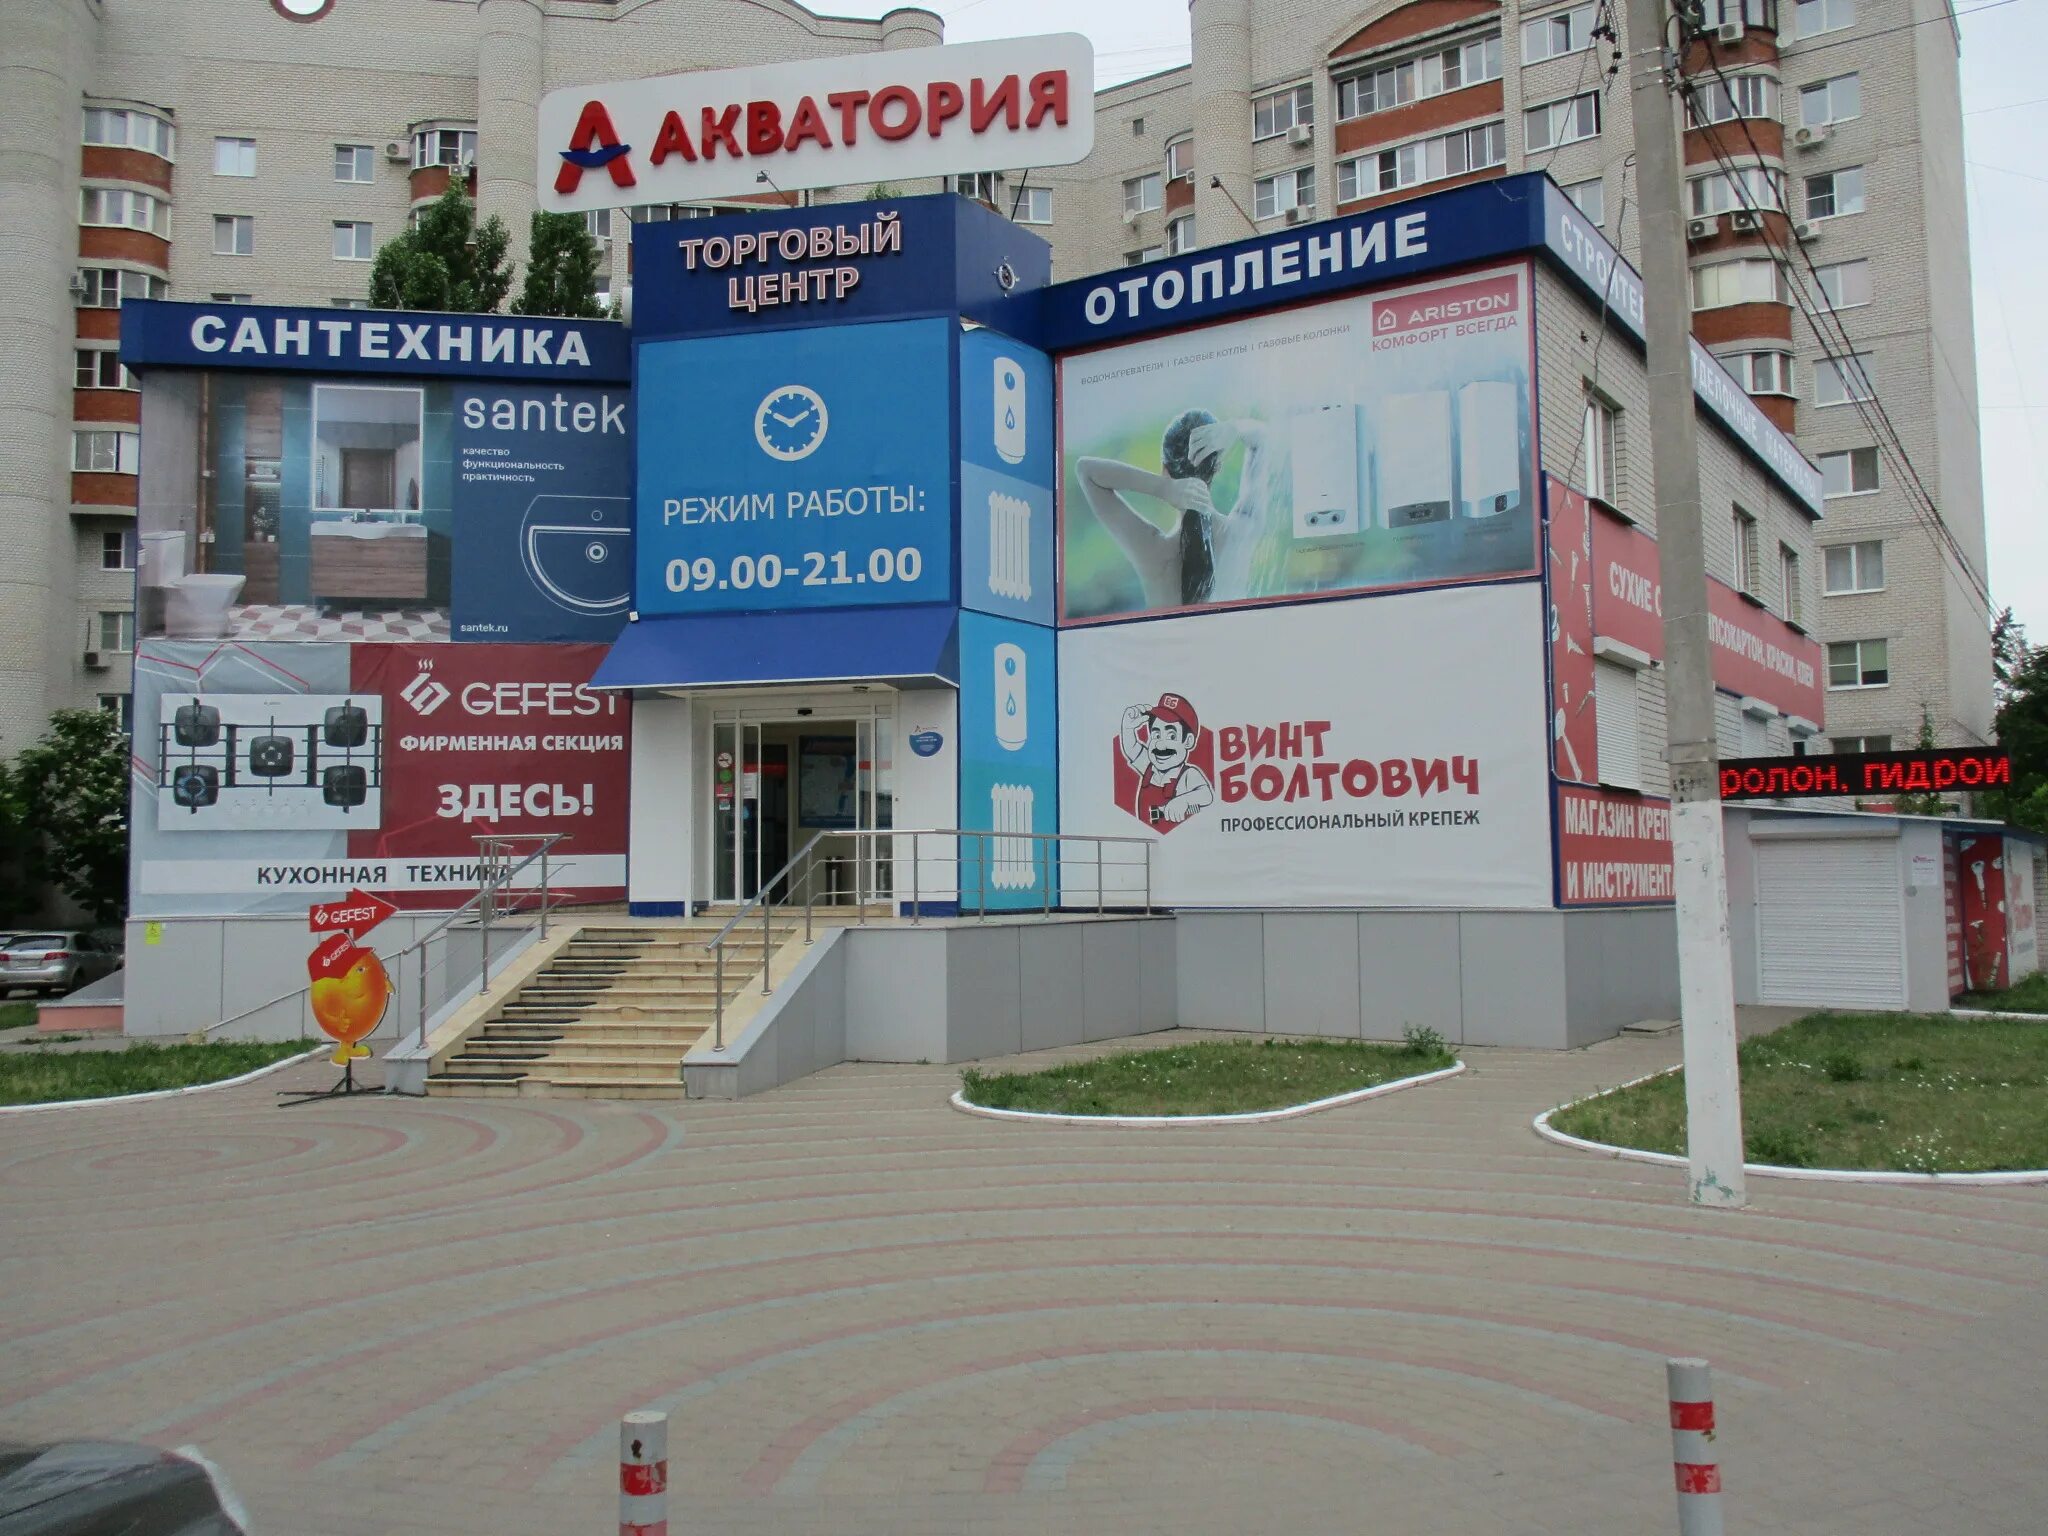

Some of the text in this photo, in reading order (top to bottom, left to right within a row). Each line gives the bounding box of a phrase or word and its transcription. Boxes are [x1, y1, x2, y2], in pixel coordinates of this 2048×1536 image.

[649, 69, 1069, 165] АКВАТОРИЯ
[678, 210, 901, 270] ТОРГОВЫЙ
[1084, 211, 1428, 325] ОТОПЛЕНИЕ
[728, 266, 860, 313] ЦЕНТР
[1407, 292, 1511, 325] ARISTON
[190, 315, 591, 366] САНТЕХНИКА
[1371, 315, 1518, 352] КОМФОРТ ВСЕГДА
[1081, 324, 1351, 385] ВОДОНАГРЕВАТЕЛИ ГАЗОВЫЕ КОТЛЫ ГАЗОВЫЕ КОЛОНКИ
[463, 392, 626, 435] santek
[462, 447, 511, 456] качество
[462, 459, 566, 471] функциональность
[462, 473, 536, 482] практичность
[663, 485, 926, 526] РЕЖИМ РАБОТЫ:
[665, 547, 923, 593] 09.00-21.00
[1609, 561, 1653, 613] СУХИЕ
[460, 623, 509, 633] santek.ru
[399, 735, 624, 753] ФИРМЕННАЯ СЕКЦИЯ
[1218, 720, 1332, 762] ВИНТ
[1218, 755, 1481, 804] БОЛТОВИЧ
[436, 783, 594, 824] ЗДЕСЬ!
[1220, 808, 1481, 833] ПРОФЕССИОНАЛЬНЫЙ КРЕПЕЖ
[1564, 796, 1671, 841] МАГАЗИН КРЕП
[257, 865, 388, 885] КУХОННАЯ
[1566, 861, 1579, 899] И
[330, 906, 377, 924] GEFEST
